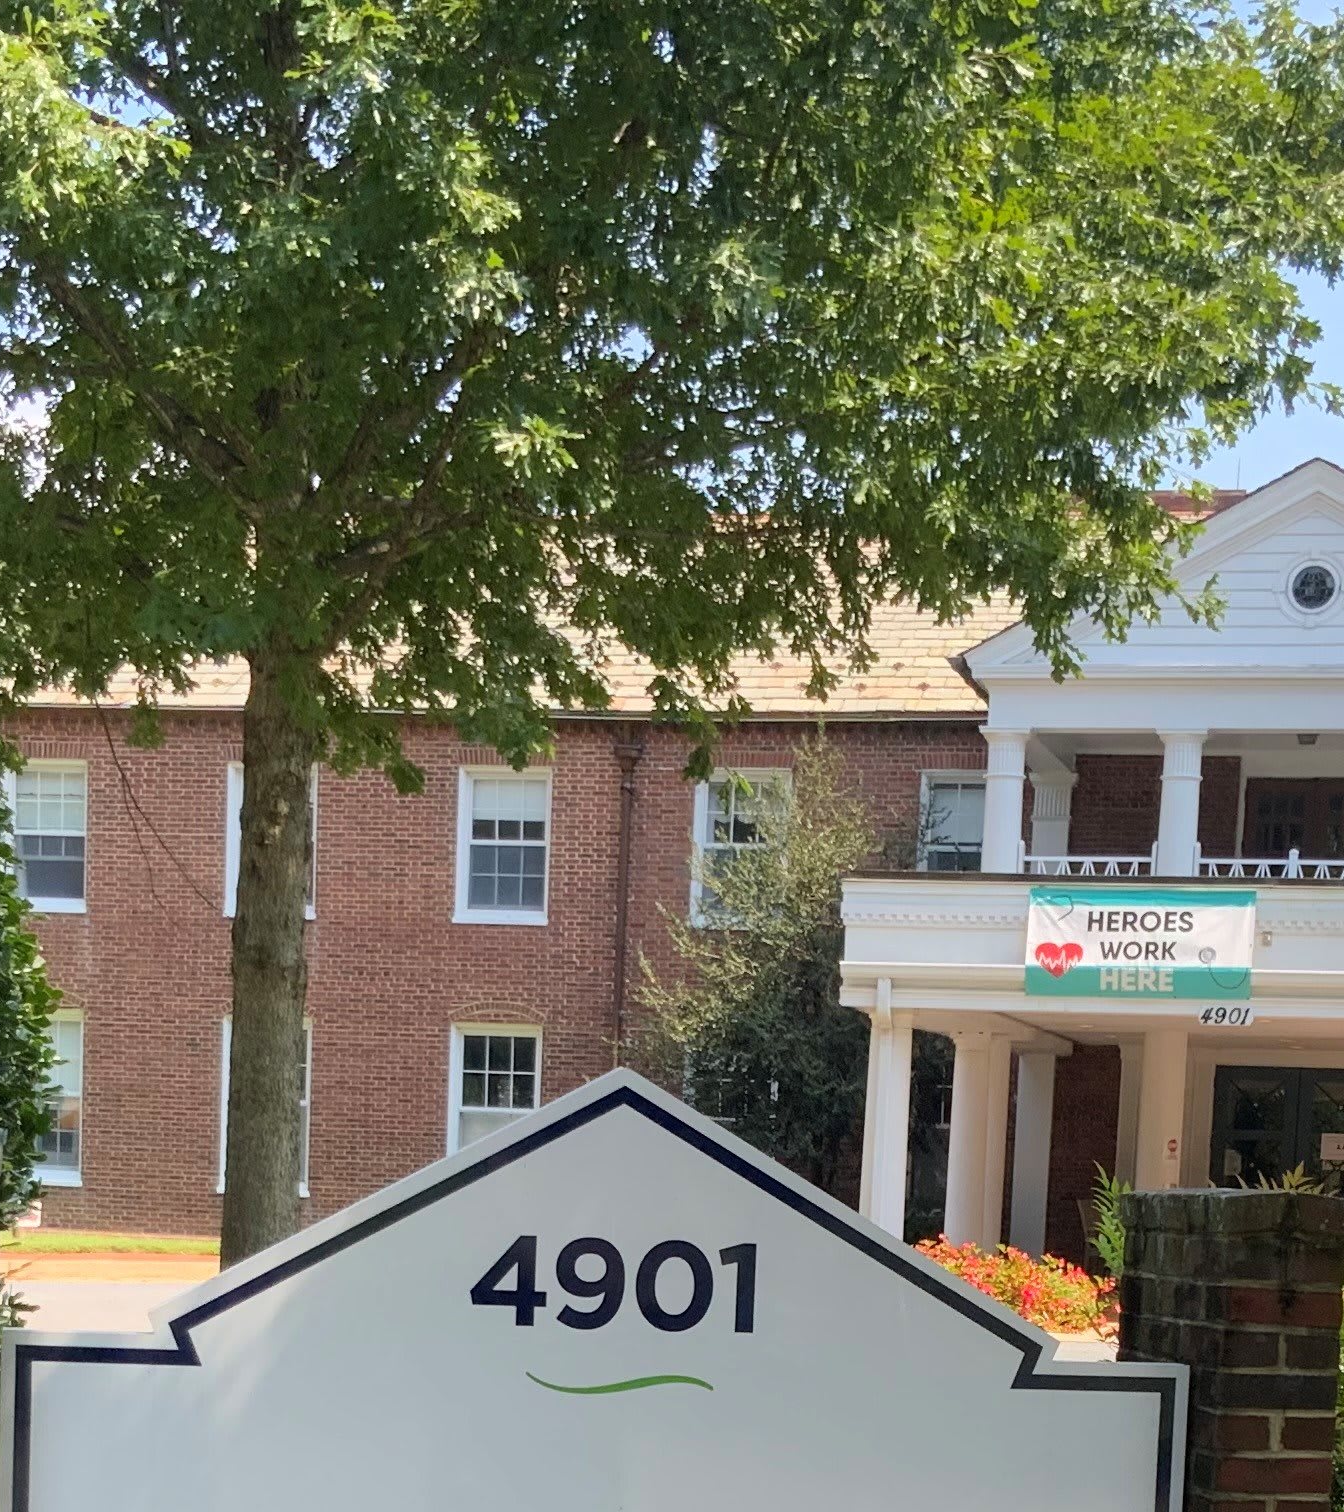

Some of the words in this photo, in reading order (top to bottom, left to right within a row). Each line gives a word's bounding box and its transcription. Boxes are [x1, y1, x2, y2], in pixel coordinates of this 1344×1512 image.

[1086, 911, 1194, 933] HEROES
[1099, 941, 1177, 961] WORK
[1099, 967, 1174, 992] HERE
[1200, 1006, 1251, 1026] 4901
[469, 1235, 757, 1334] 4901
